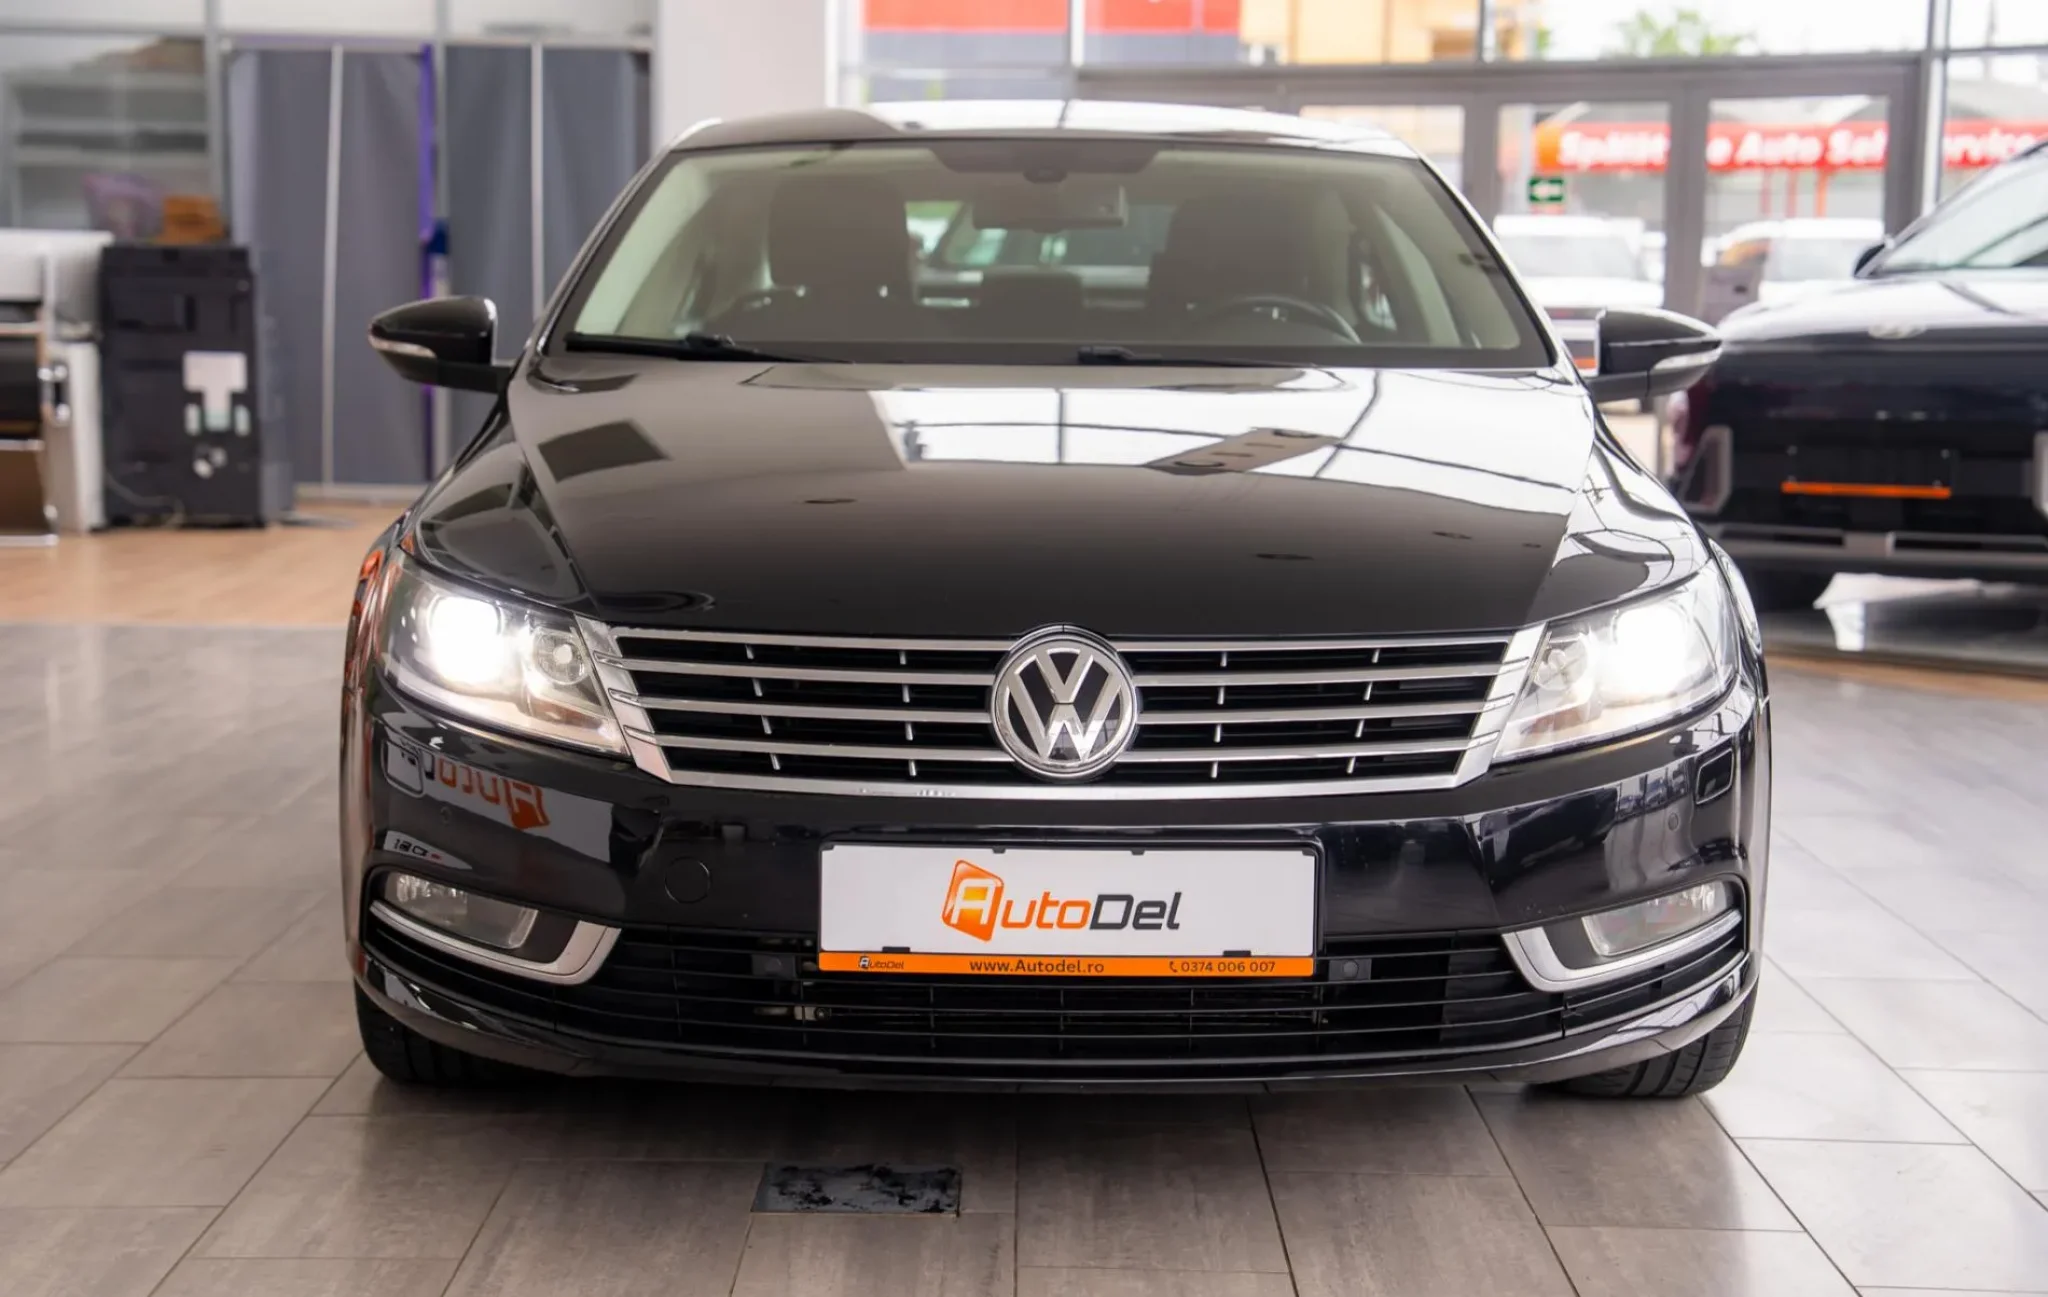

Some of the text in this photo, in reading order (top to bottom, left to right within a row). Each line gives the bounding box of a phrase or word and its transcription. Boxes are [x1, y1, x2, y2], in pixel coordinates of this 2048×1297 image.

[1736, 131, 1821, 164] Auto
[1829, 129, 1887, 164] Sel
[949, 874, 1183, 932] AutoDel
[859, 955, 905, 970] AutoDel
[969, 959, 1105, 974] www.Autodel.ro
[1180, 961, 1277, 974] 0374 006 007
